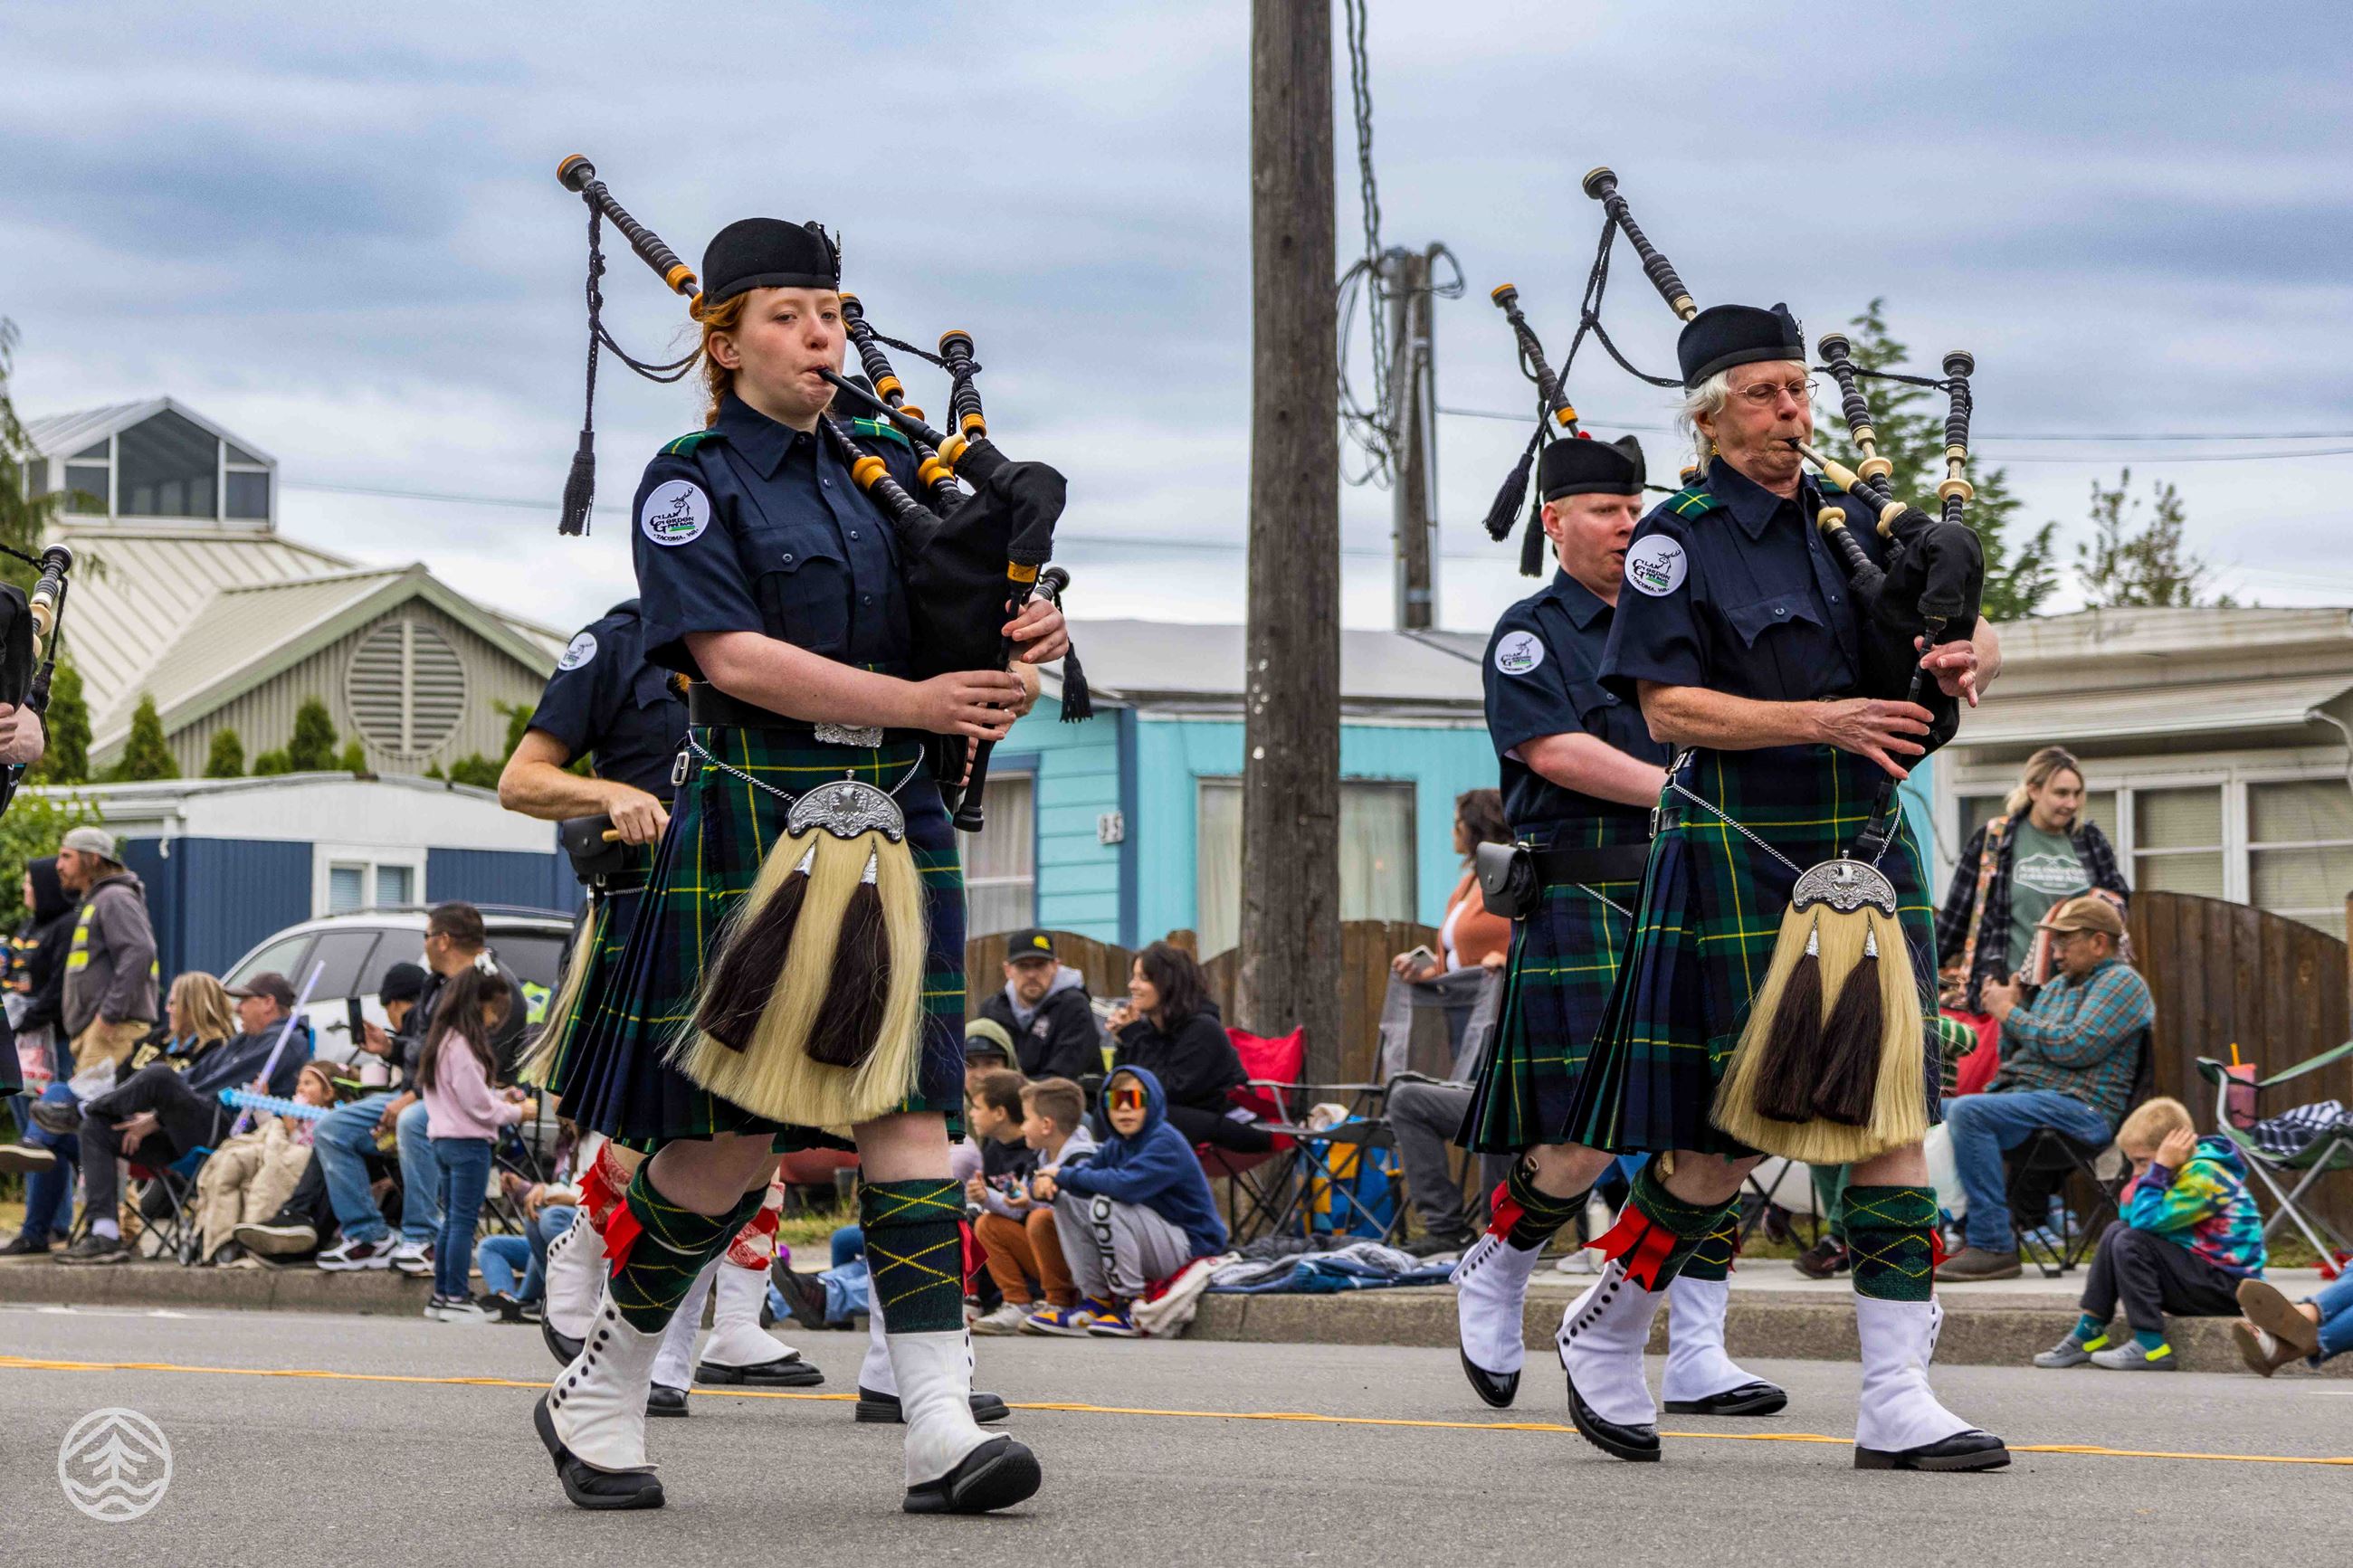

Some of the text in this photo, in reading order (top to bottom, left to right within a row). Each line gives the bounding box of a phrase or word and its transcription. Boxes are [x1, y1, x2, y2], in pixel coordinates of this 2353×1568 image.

[650, 512, 679, 526] CLAN
[653, 516, 694, 534] GORDON
[1633, 558, 1659, 570] CLAN
[1634, 565, 1671, 580] GORDON
